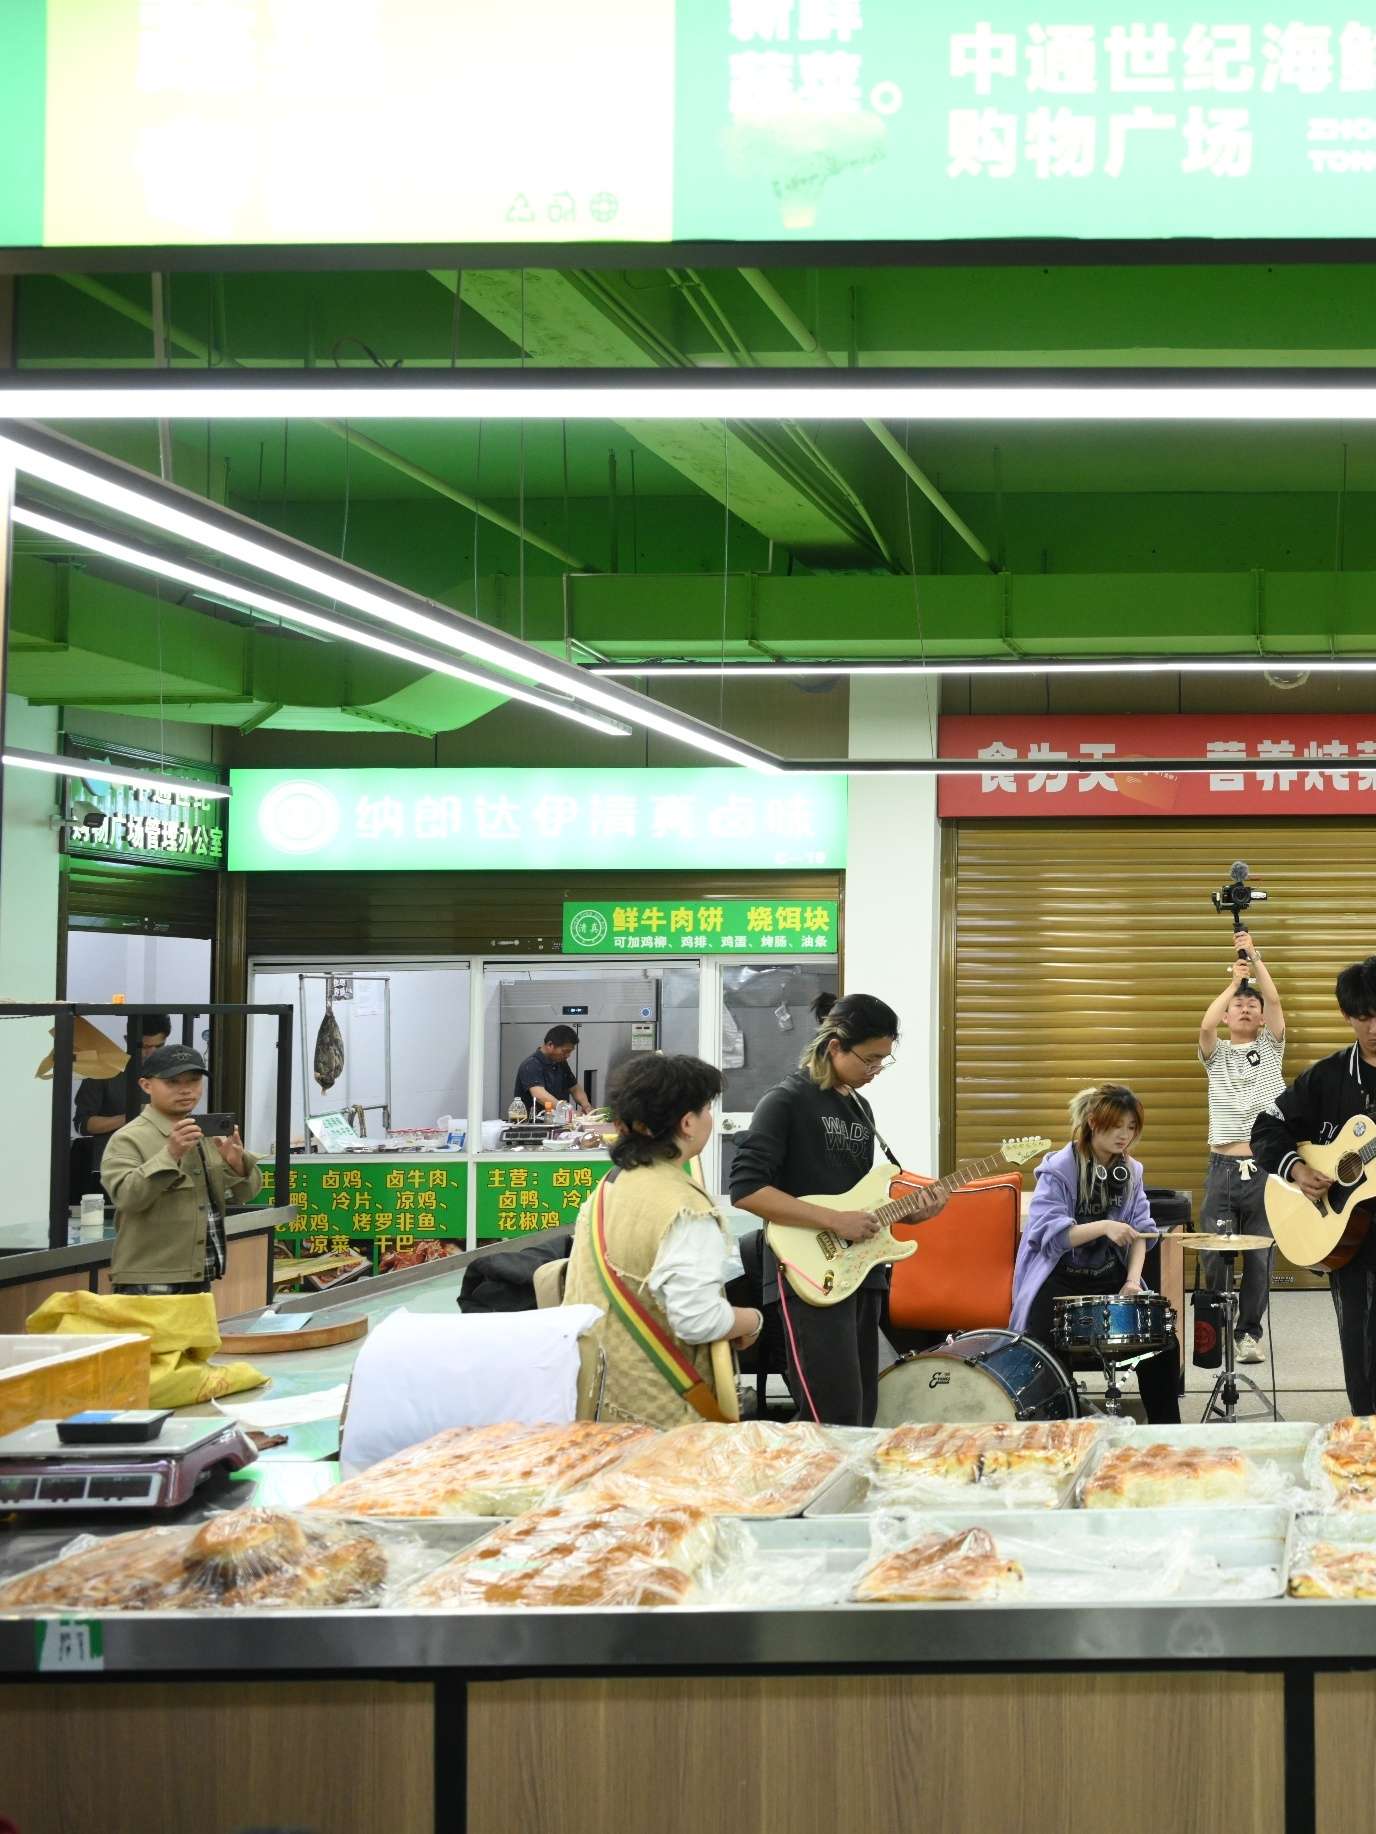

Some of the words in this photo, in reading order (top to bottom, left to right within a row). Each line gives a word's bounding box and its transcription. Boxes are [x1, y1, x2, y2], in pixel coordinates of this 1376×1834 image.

[947, 106, 1252, 179] 购物广场
[976, 741, 1119, 793] 食为天
[612, 906, 725, 934] 鲜牛肉饼
[747, 906, 831, 934] 烧饵块
[268, 1191, 448, 1211] 鸭、冷片、凉鸡、
[274, 1212, 448, 1232] 椒鸡、烤罗非鱼、
